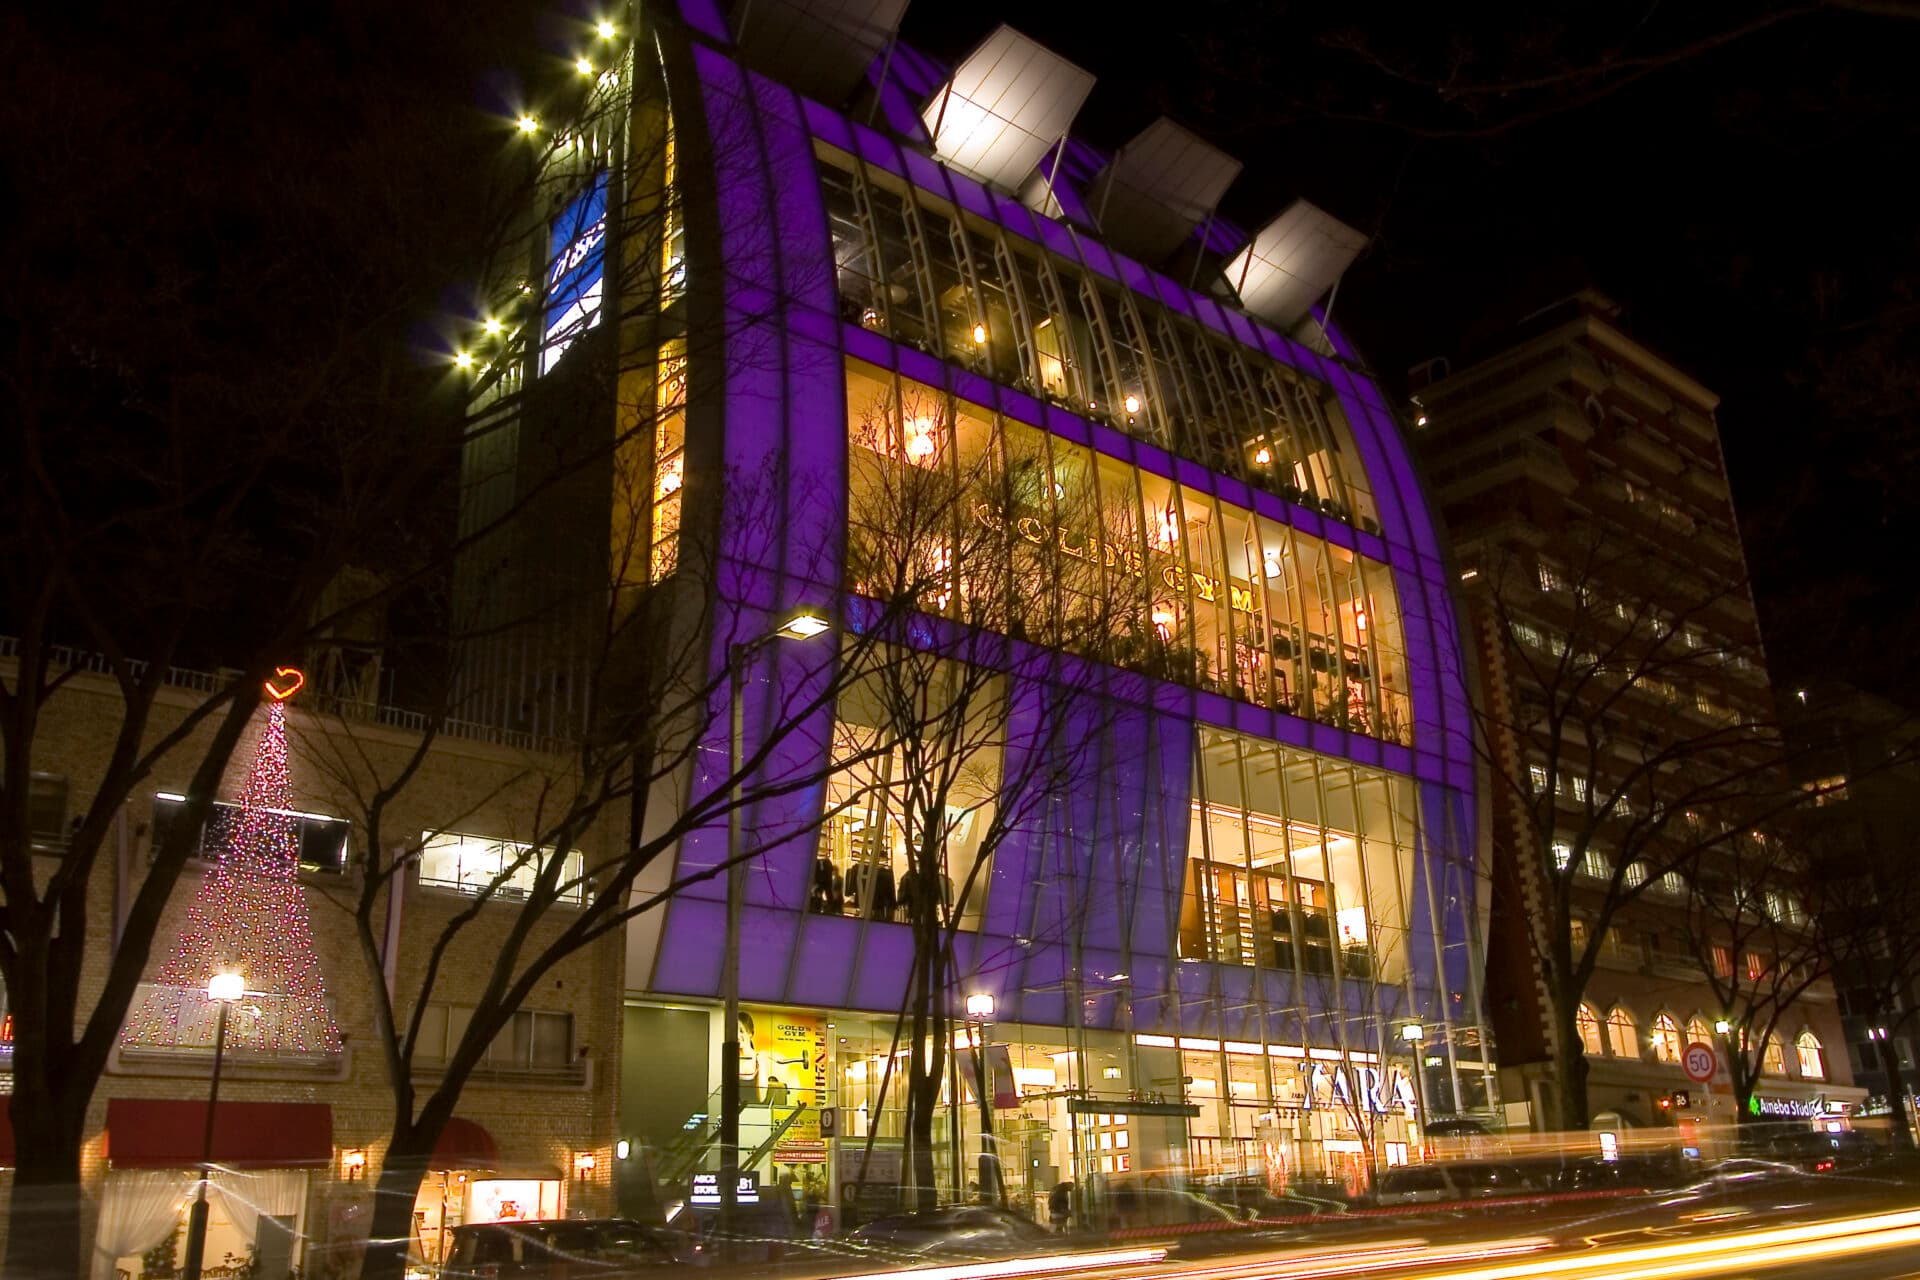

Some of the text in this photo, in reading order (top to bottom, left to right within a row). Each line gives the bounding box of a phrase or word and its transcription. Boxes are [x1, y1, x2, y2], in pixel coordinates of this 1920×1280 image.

[1163, 565, 1254, 613] GYM
[1689, 1053, 1710, 1073] 50
[1299, 1062, 1416, 1113] ZARA
[1760, 1098, 1791, 1115] Ameba
[693, 1185, 719, 1195] STORE
[740, 1177, 753, 1190] B1
